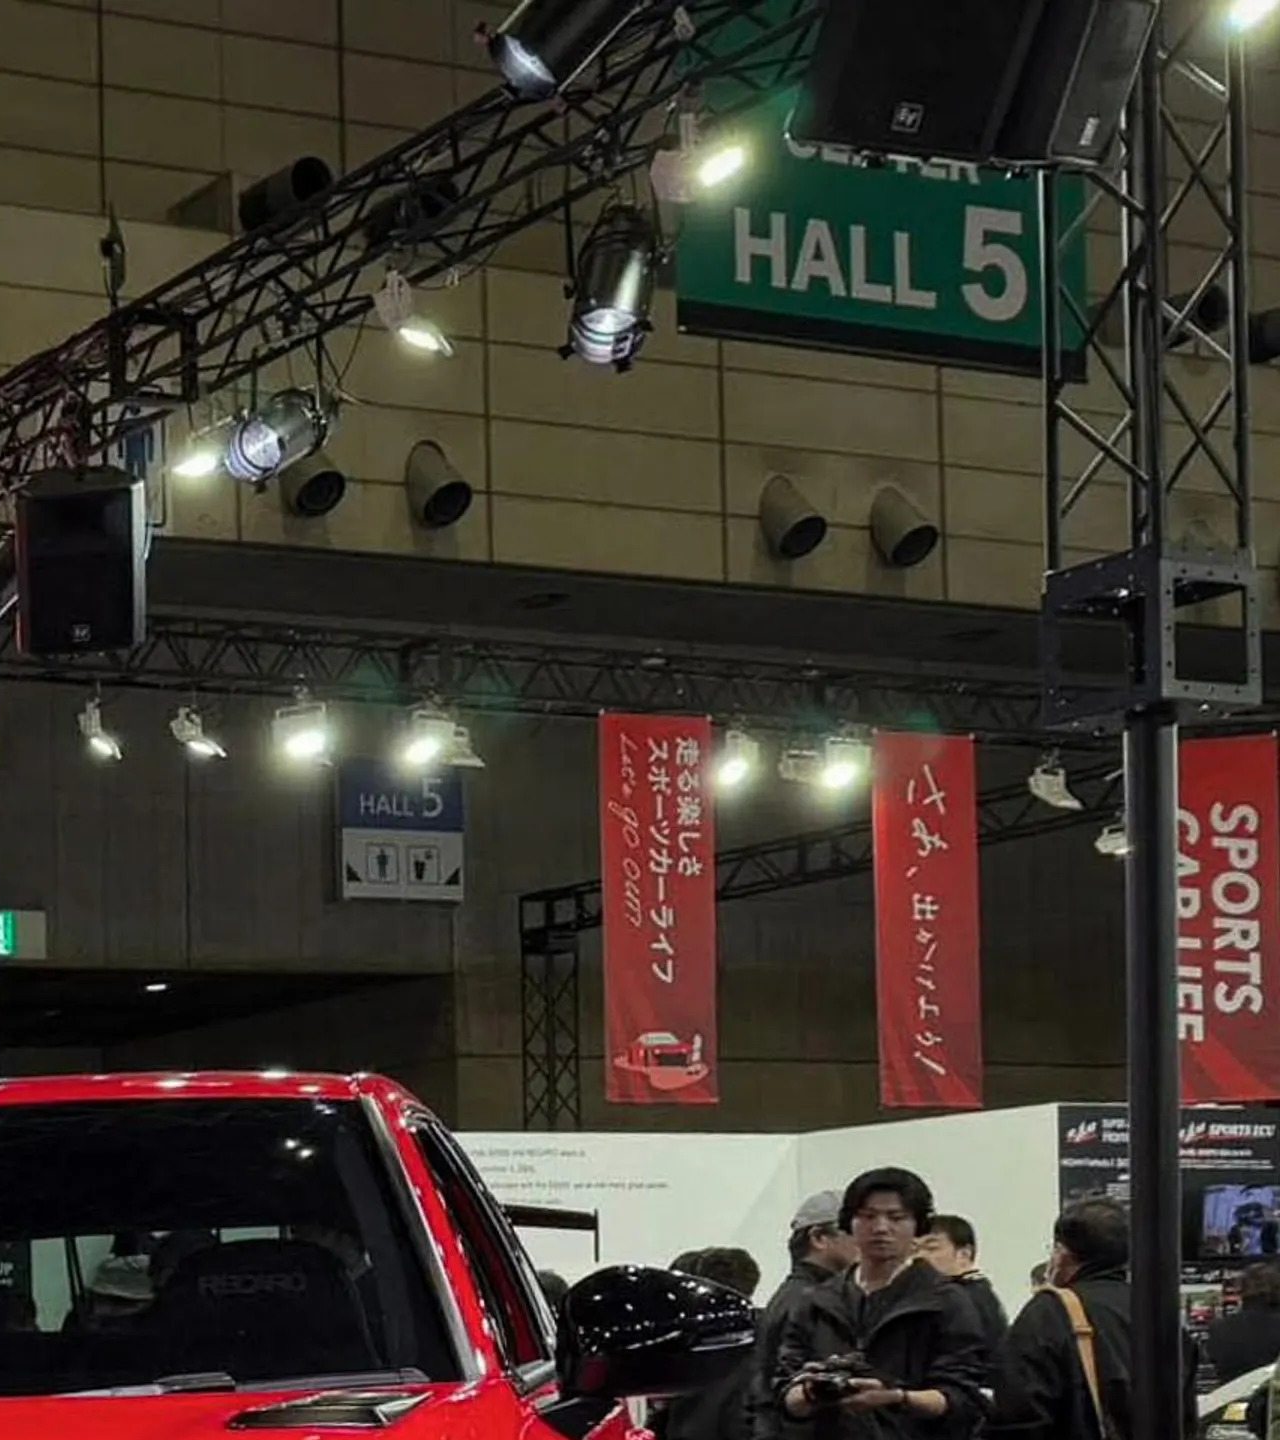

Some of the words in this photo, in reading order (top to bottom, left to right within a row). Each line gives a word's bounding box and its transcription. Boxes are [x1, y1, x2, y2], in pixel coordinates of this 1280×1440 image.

[734, 206, 938, 310] HALL
[960, 205, 1028, 321] 5
[359, 792, 414, 817] HALL
[421, 777, 444, 818] 5
[608, 800, 640, 848] go
[647, 737, 674, 984] スポーツカーライフ
[675, 736, 702, 877] 走る楽しさ
[1209, 801, 1264, 1015] SPORTS
